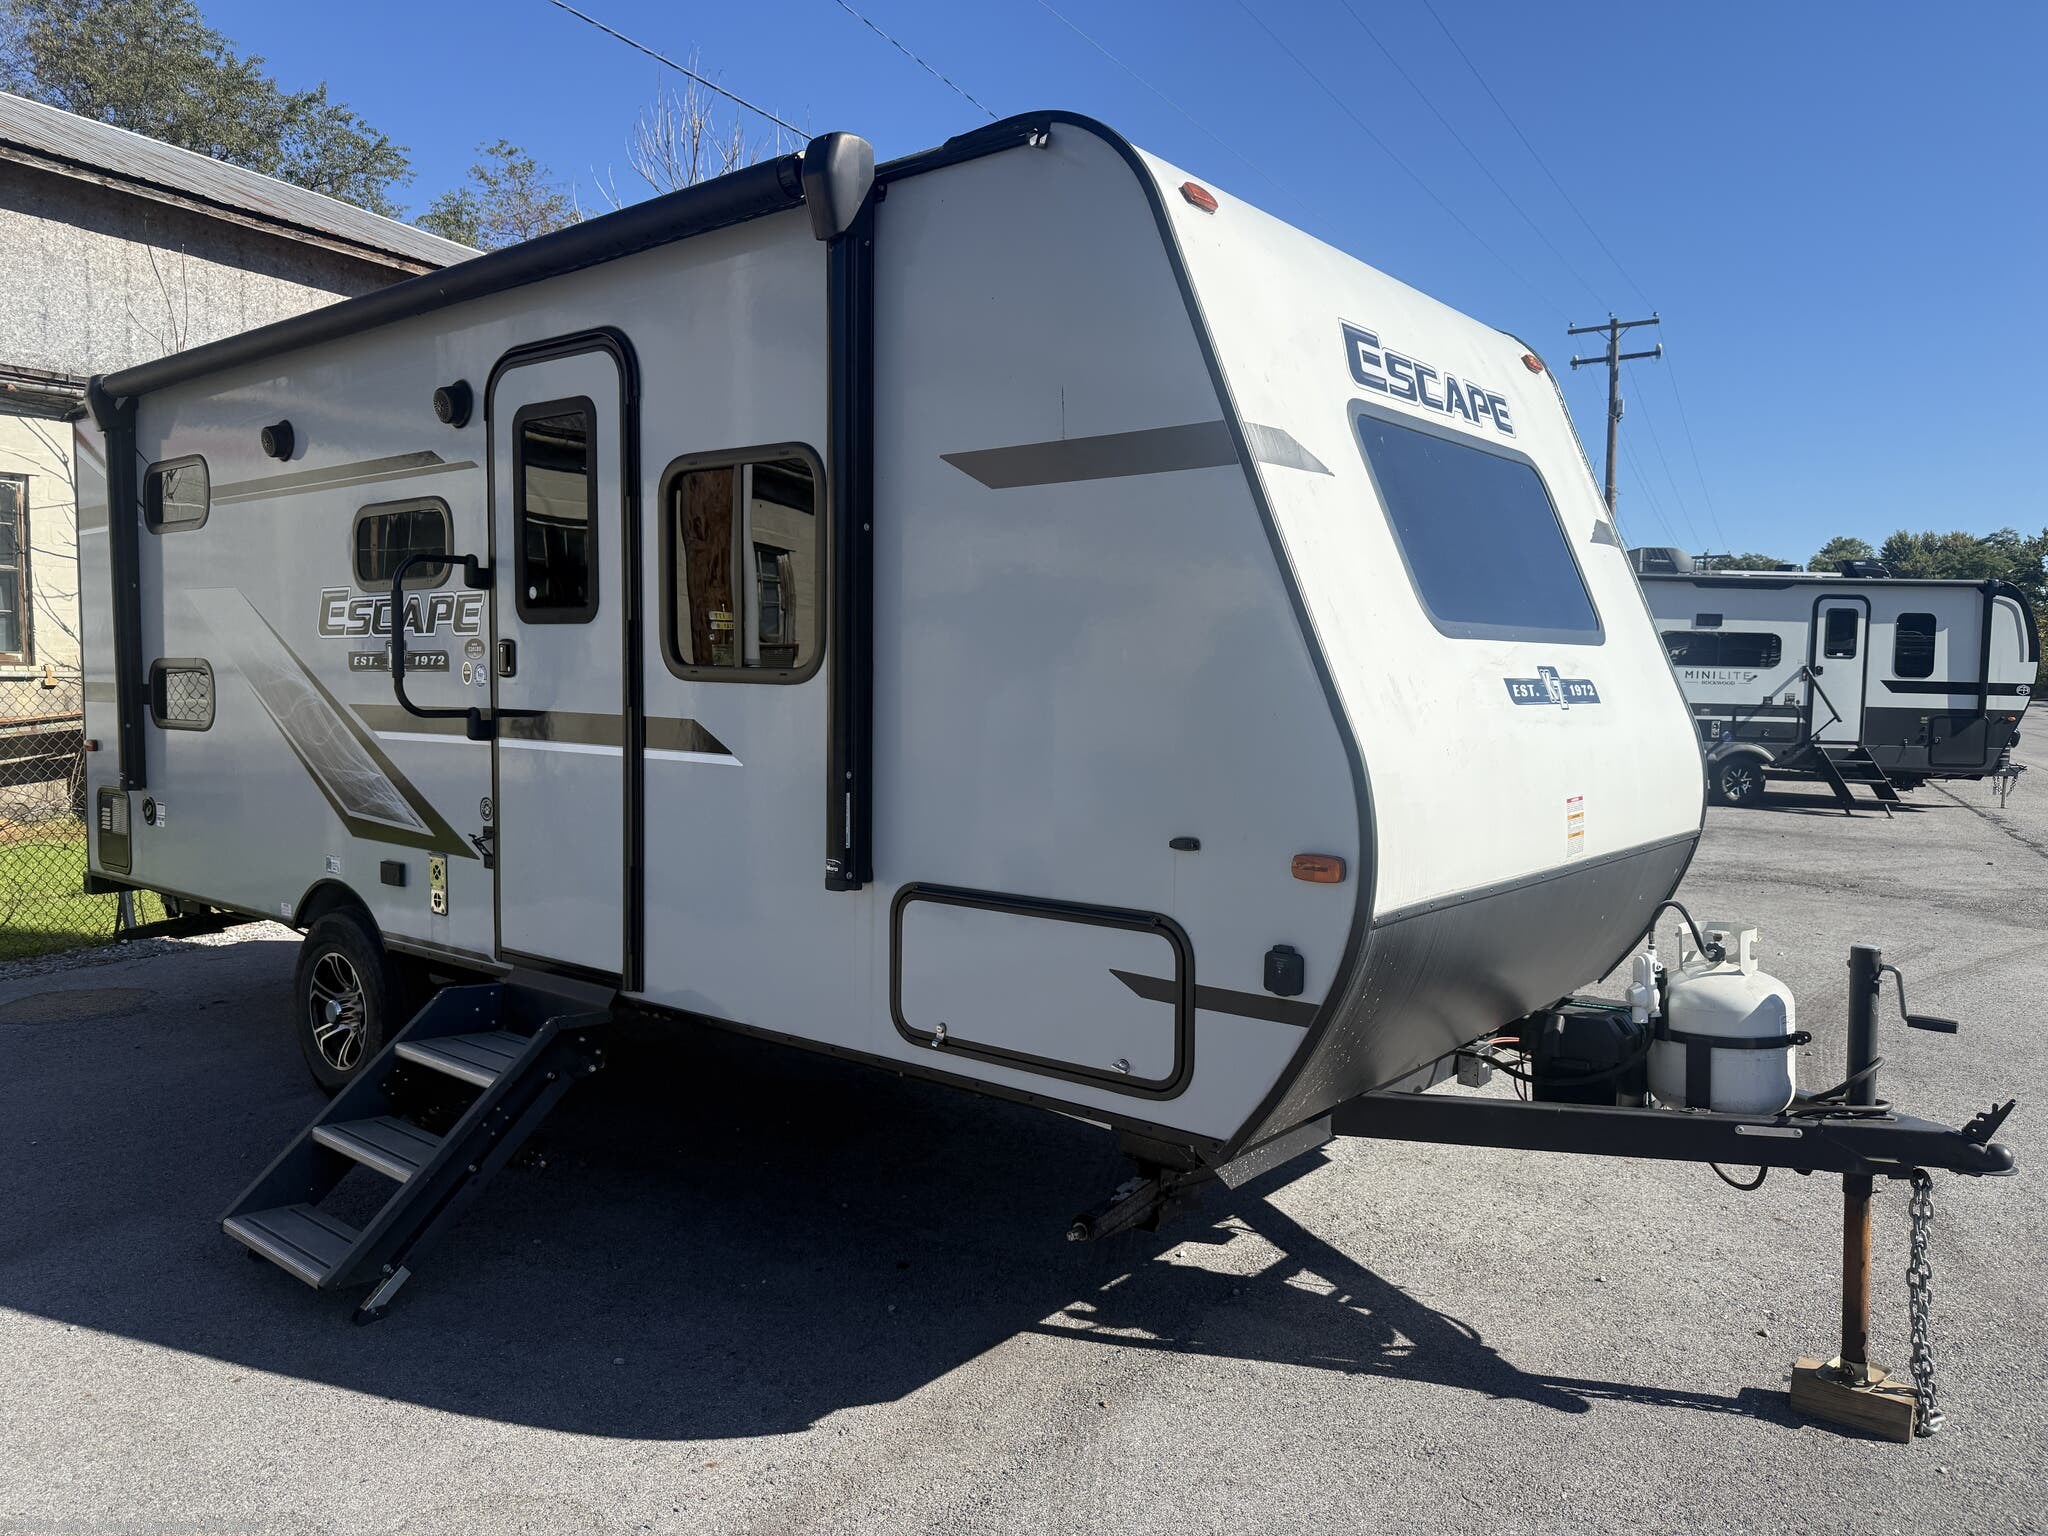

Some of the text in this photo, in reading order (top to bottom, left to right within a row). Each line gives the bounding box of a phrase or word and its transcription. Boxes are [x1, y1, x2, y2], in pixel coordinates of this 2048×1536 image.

[1339, 319, 1515, 437] ESCAPE
[318, 586, 484, 637] ESCAPE
[353, 656, 445, 666] EST. 1972
[1512, 684, 1540, 697] EST.
[1569, 684, 1595, 696] 1972
